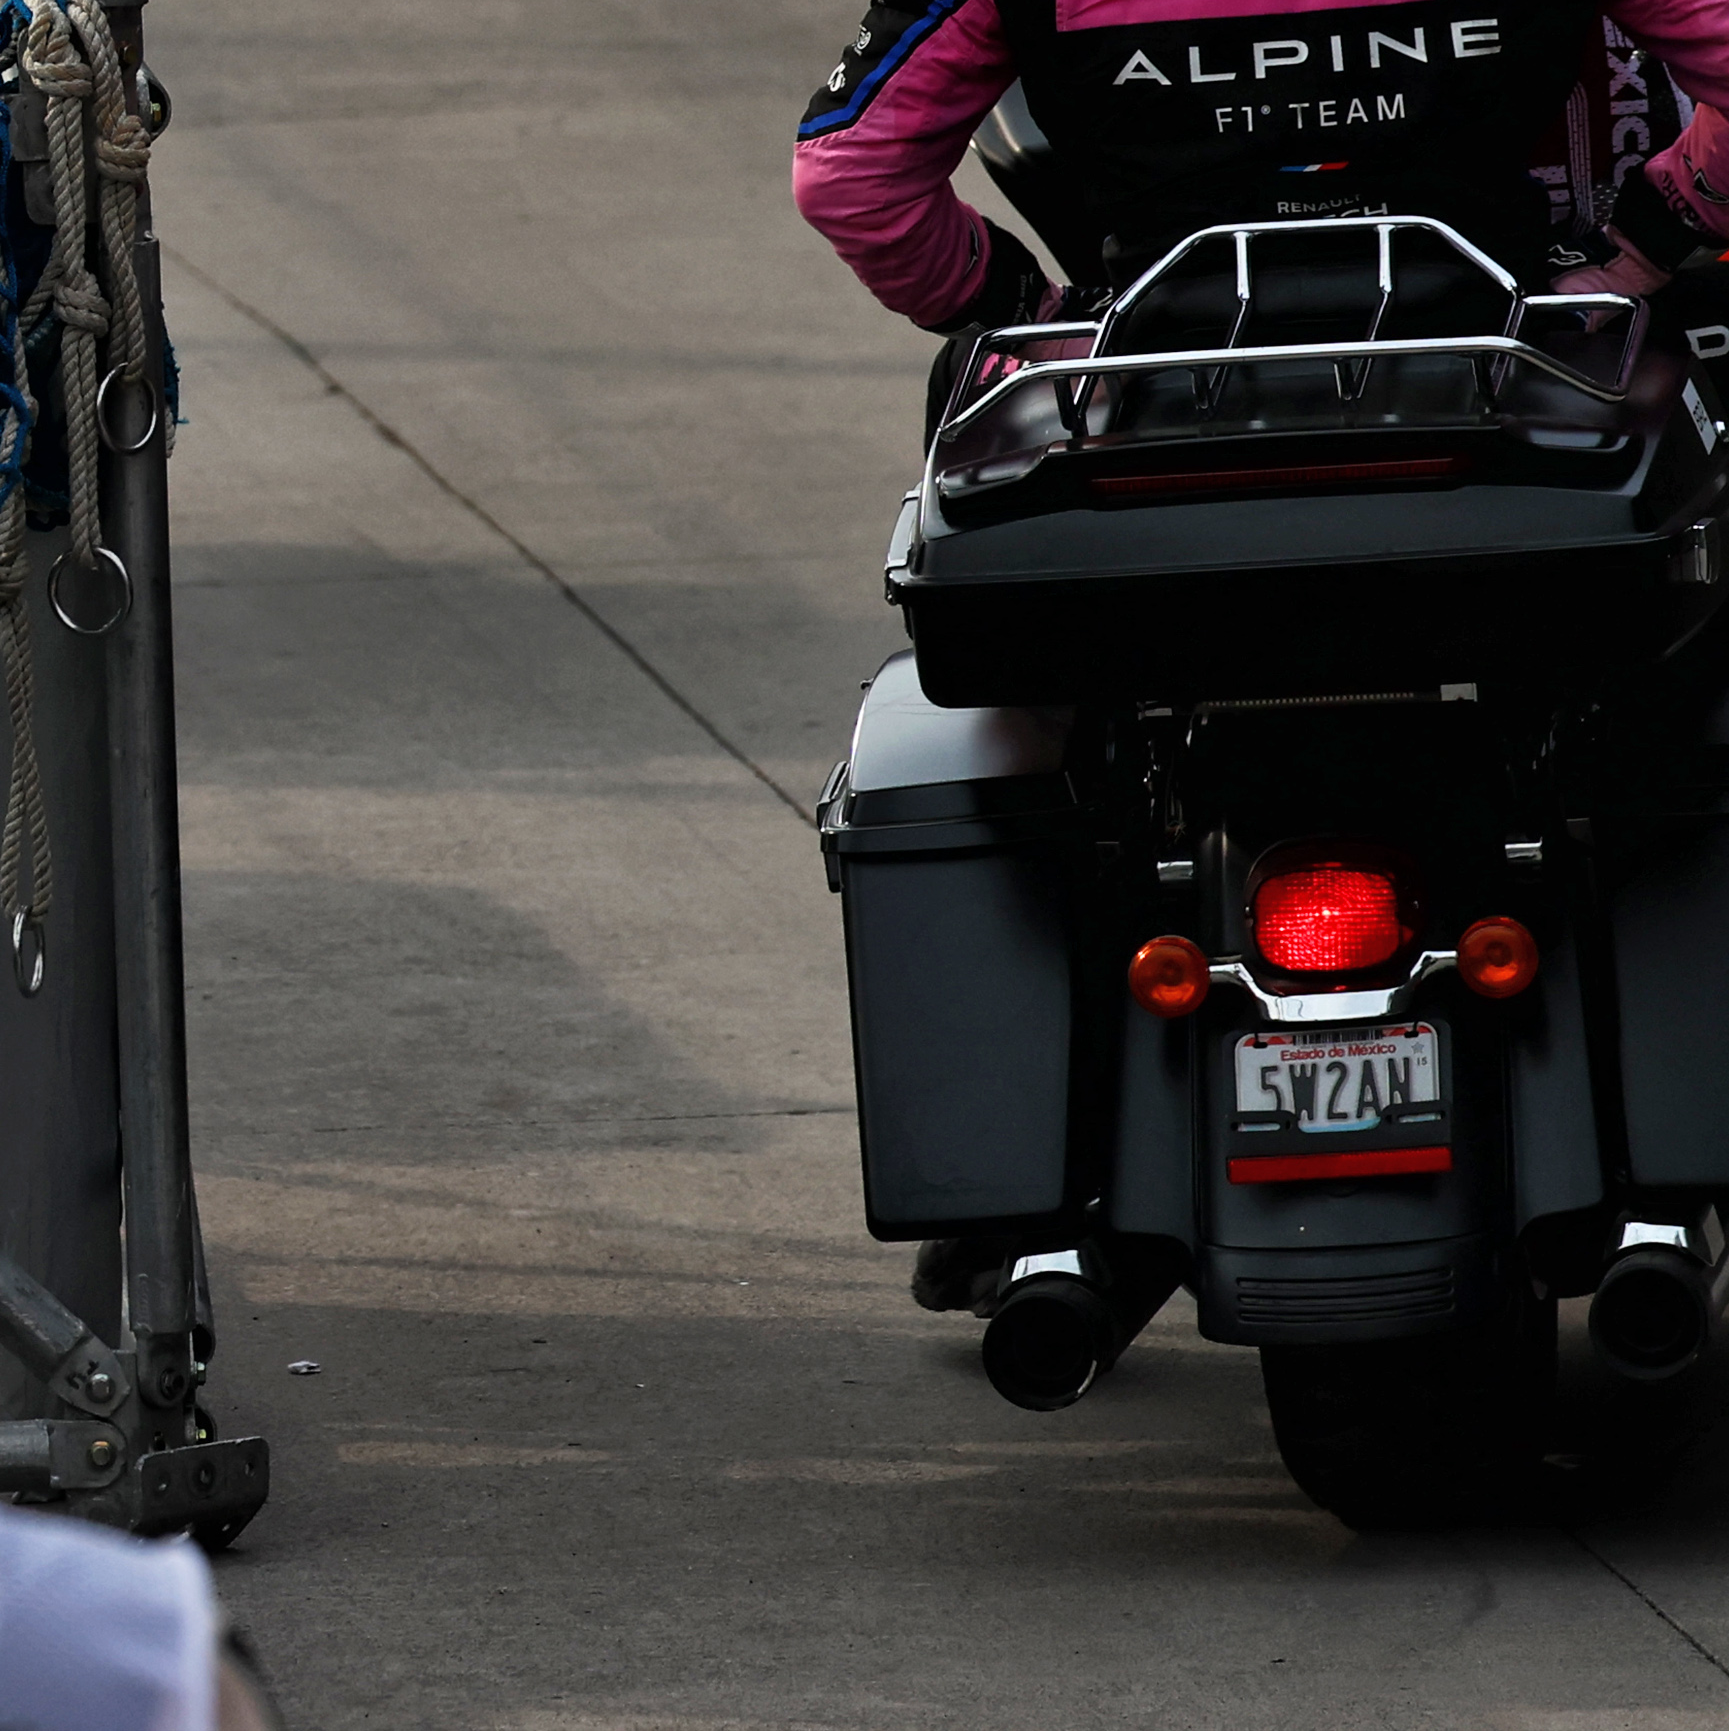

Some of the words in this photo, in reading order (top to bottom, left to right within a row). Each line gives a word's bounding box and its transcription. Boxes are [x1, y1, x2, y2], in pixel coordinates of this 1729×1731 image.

[1112, 18, 1502, 86] ALPINE
[1288, 93, 1406, 130] TEAM
[1277, 194, 1361, 214] RENAULT
[1280, 1048, 1326, 1062] Estado
[1328, 1046, 1345, 1058] de
[1347, 1042, 1398, 1057] México
[1259, 1057, 1411, 1123] 5W2AN
